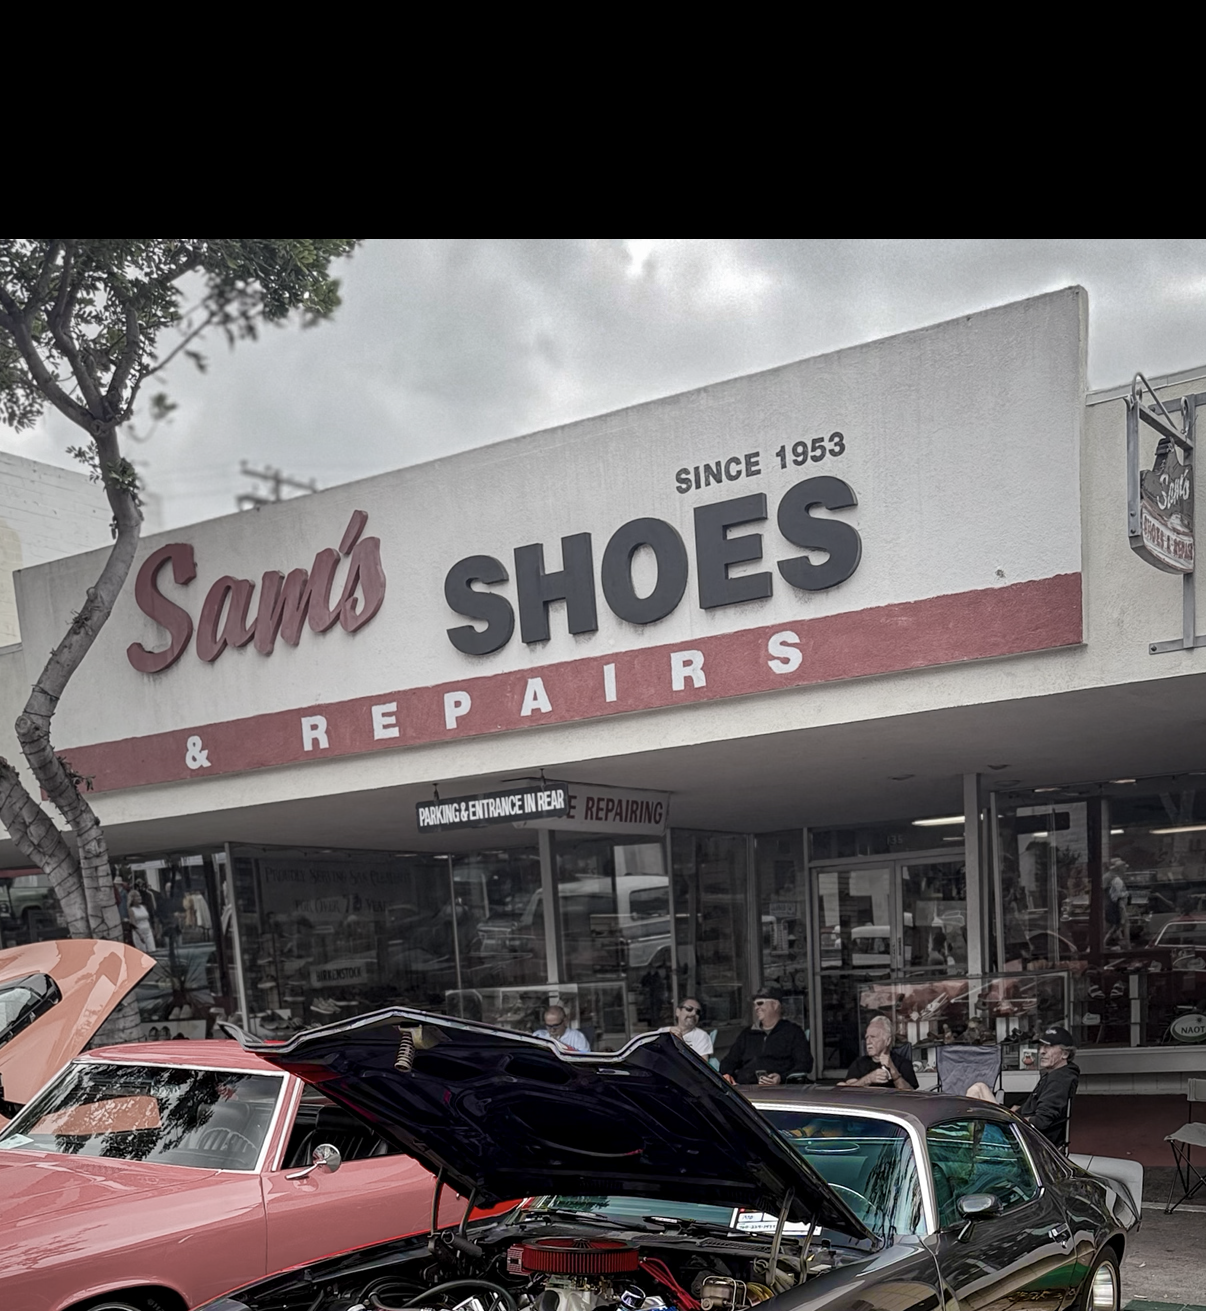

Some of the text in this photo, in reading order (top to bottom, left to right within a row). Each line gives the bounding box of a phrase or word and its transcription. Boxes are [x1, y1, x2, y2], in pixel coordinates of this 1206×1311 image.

[675, 431, 846, 494] SINCE 1953
[126, 475, 862, 673] Sam's SHOES
[185, 630, 803, 769] & REPAIRS
[418, 803, 460, 827] PARKING
[469, 794, 523, 820] ENTRANCE
[524, 793, 536, 813] IN
[537, 789, 565, 811] REAR
[584, 796, 663, 825] REPAIRING
[1181, 1025, 1205, 1034] NAOT
